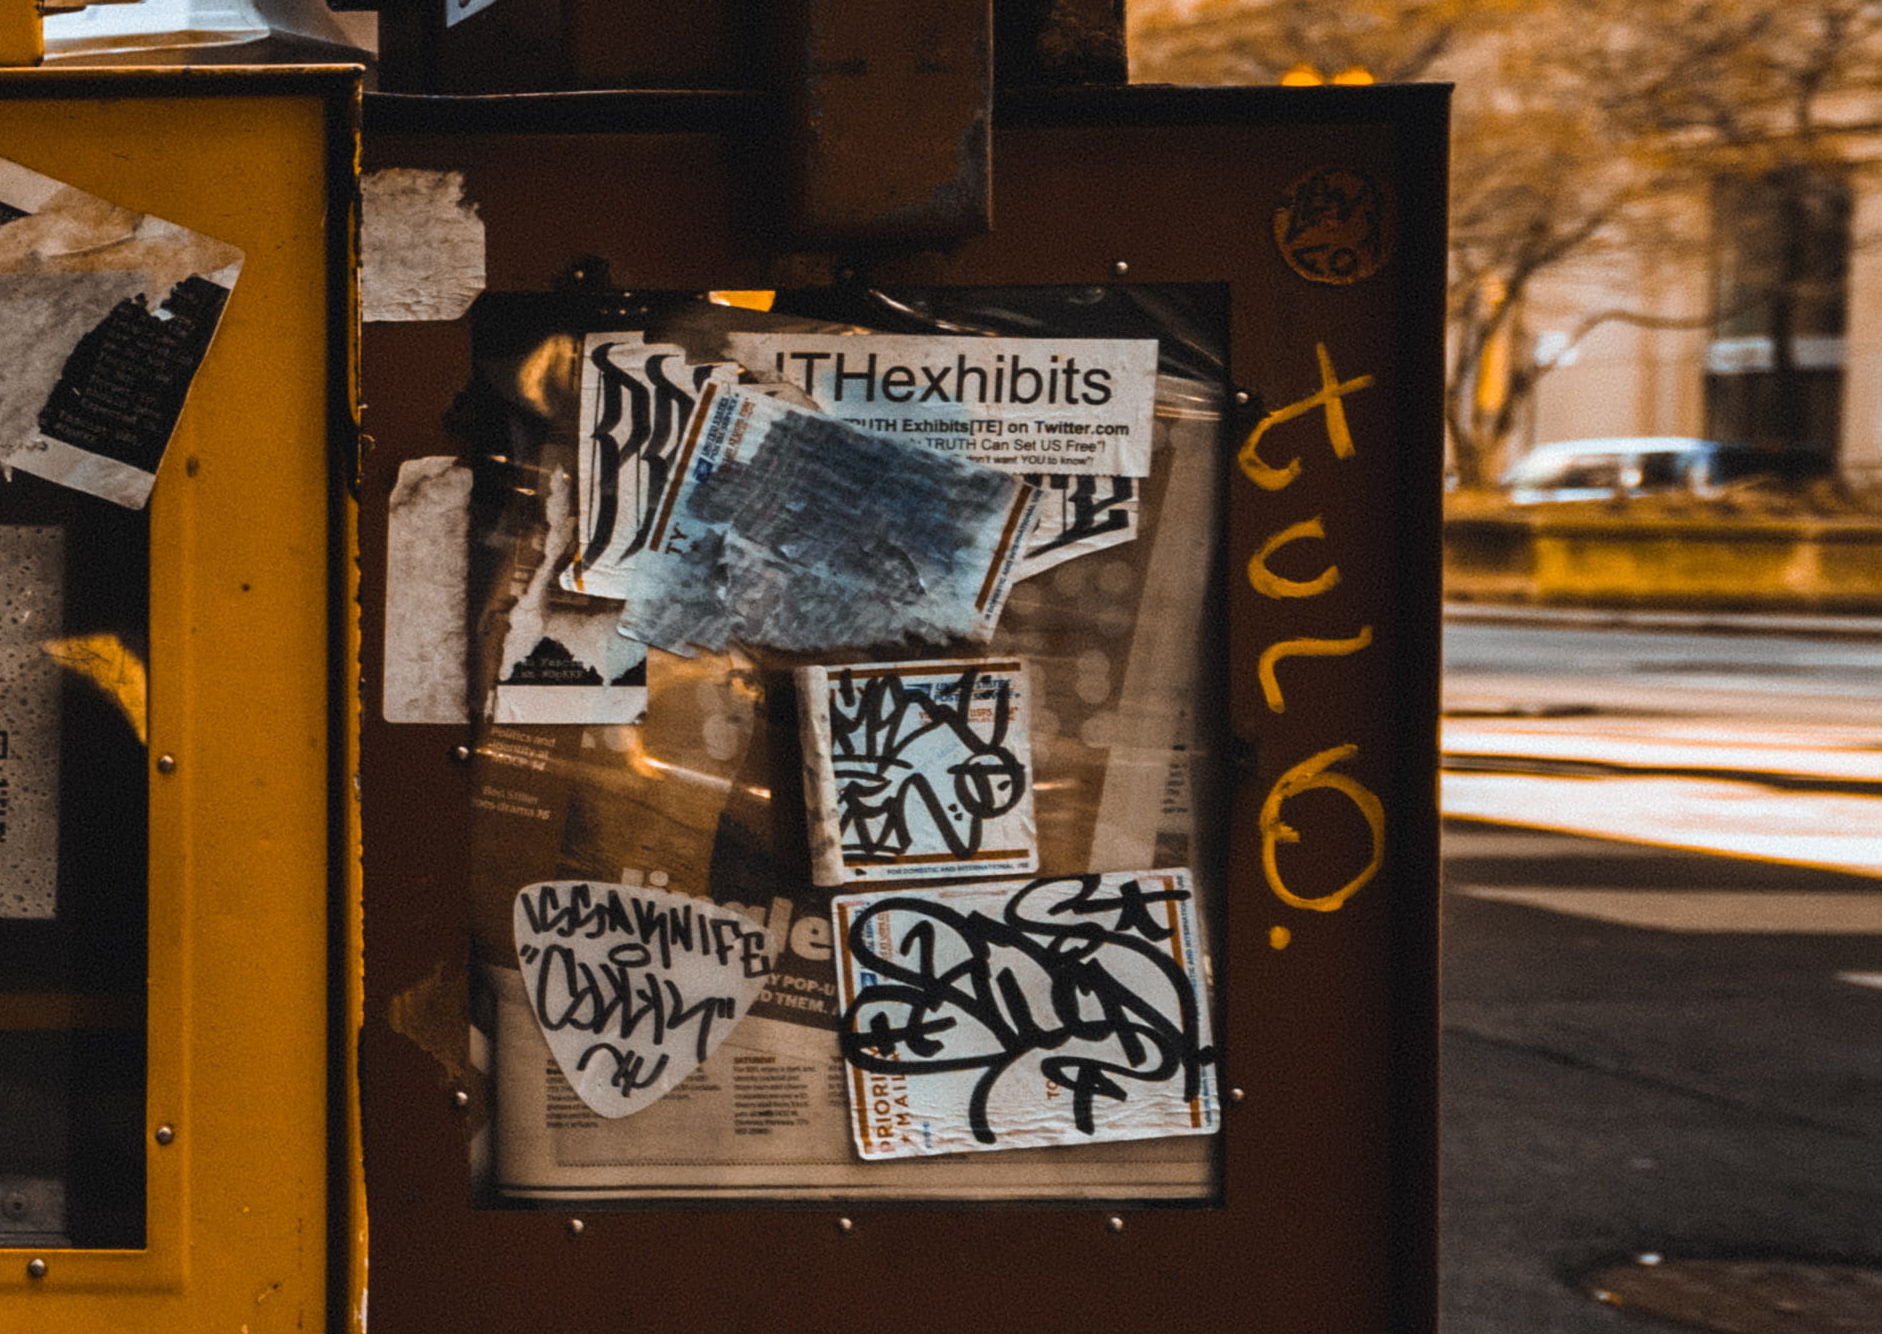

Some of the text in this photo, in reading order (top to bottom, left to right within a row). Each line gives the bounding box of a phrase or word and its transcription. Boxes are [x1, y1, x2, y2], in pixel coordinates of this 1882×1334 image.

[902, 419, 1003, 436] Exhibits[TE]
[1007, 422, 1029, 434] on
[1034, 421, 1129, 436] Twitter.com
[926, 437, 977, 452] TRUTH
[981, 438, 1010, 452] Can
[1013, 438, 1037, 452] Set
[1040, 438, 1062, 452] US
